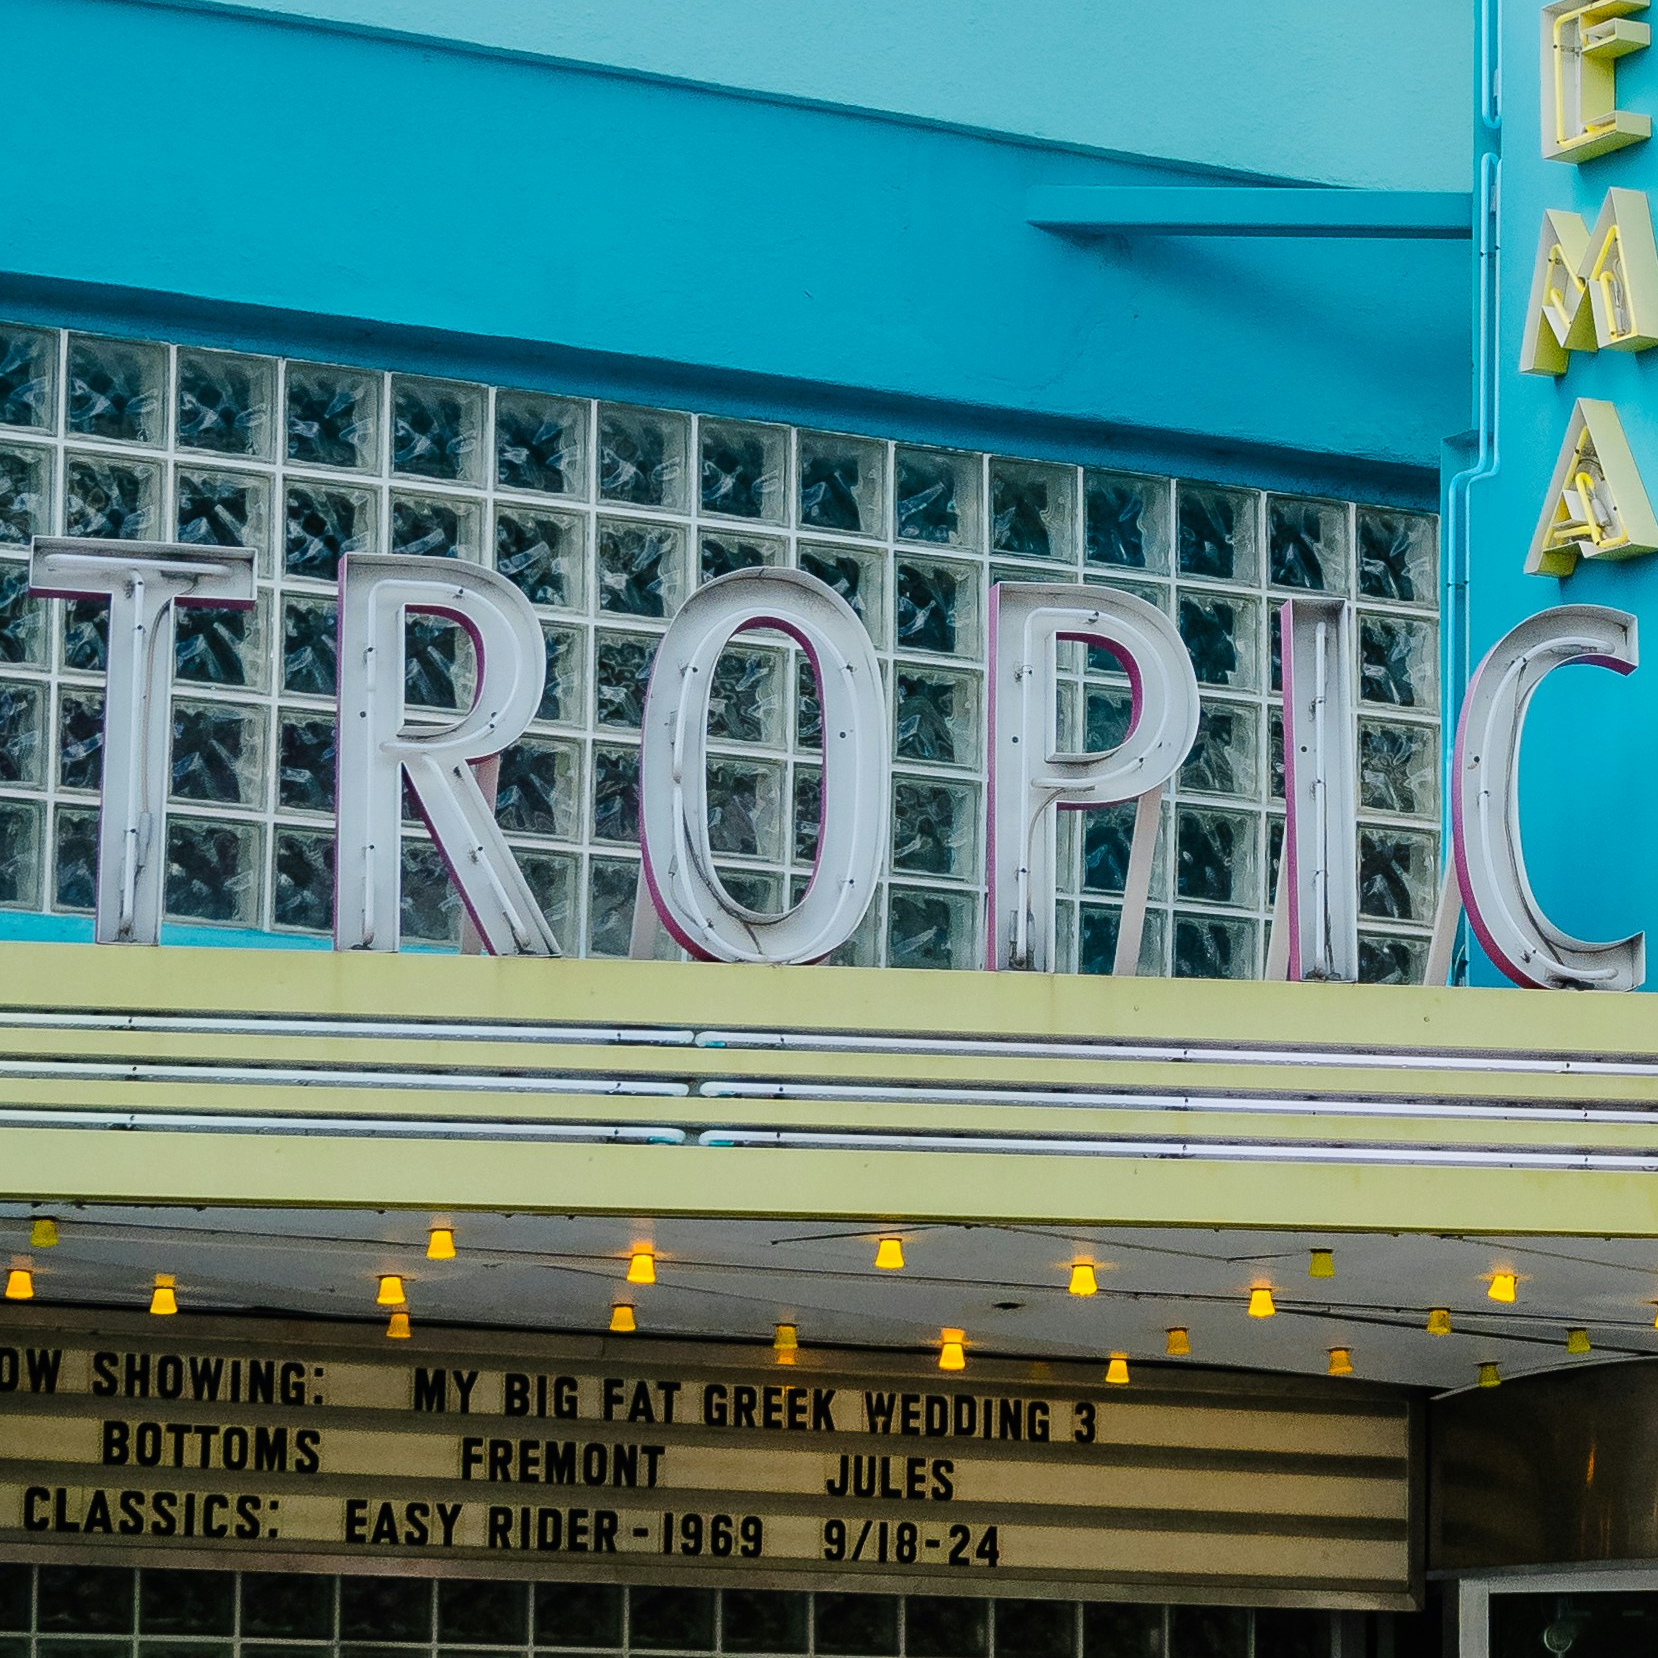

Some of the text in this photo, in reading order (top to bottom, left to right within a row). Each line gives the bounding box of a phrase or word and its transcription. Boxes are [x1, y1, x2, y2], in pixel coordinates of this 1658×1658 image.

[28, 535, 1646, 993] TROPIC
[92, 1351, 325, 1407] SHOWING:
[413, 1368, 480, 1414] MY
[504, 1373, 579, 1421] BIG
[603, 1379, 682, 1426] FAT
[703, 1384, 837, 1433] GREEK
[864, 1391, 1050, 1442] WEDDING
[1075, 1402, 1097, 1443] 3
[102, 1420, 956, 1502] BOTTOMS FREMONT JULES
[23, 1486, 280, 1540] CLASSICS:
[345, 1499, 464, 1546] EASY
[823, 1519, 1000, 1568] 9/18-24
